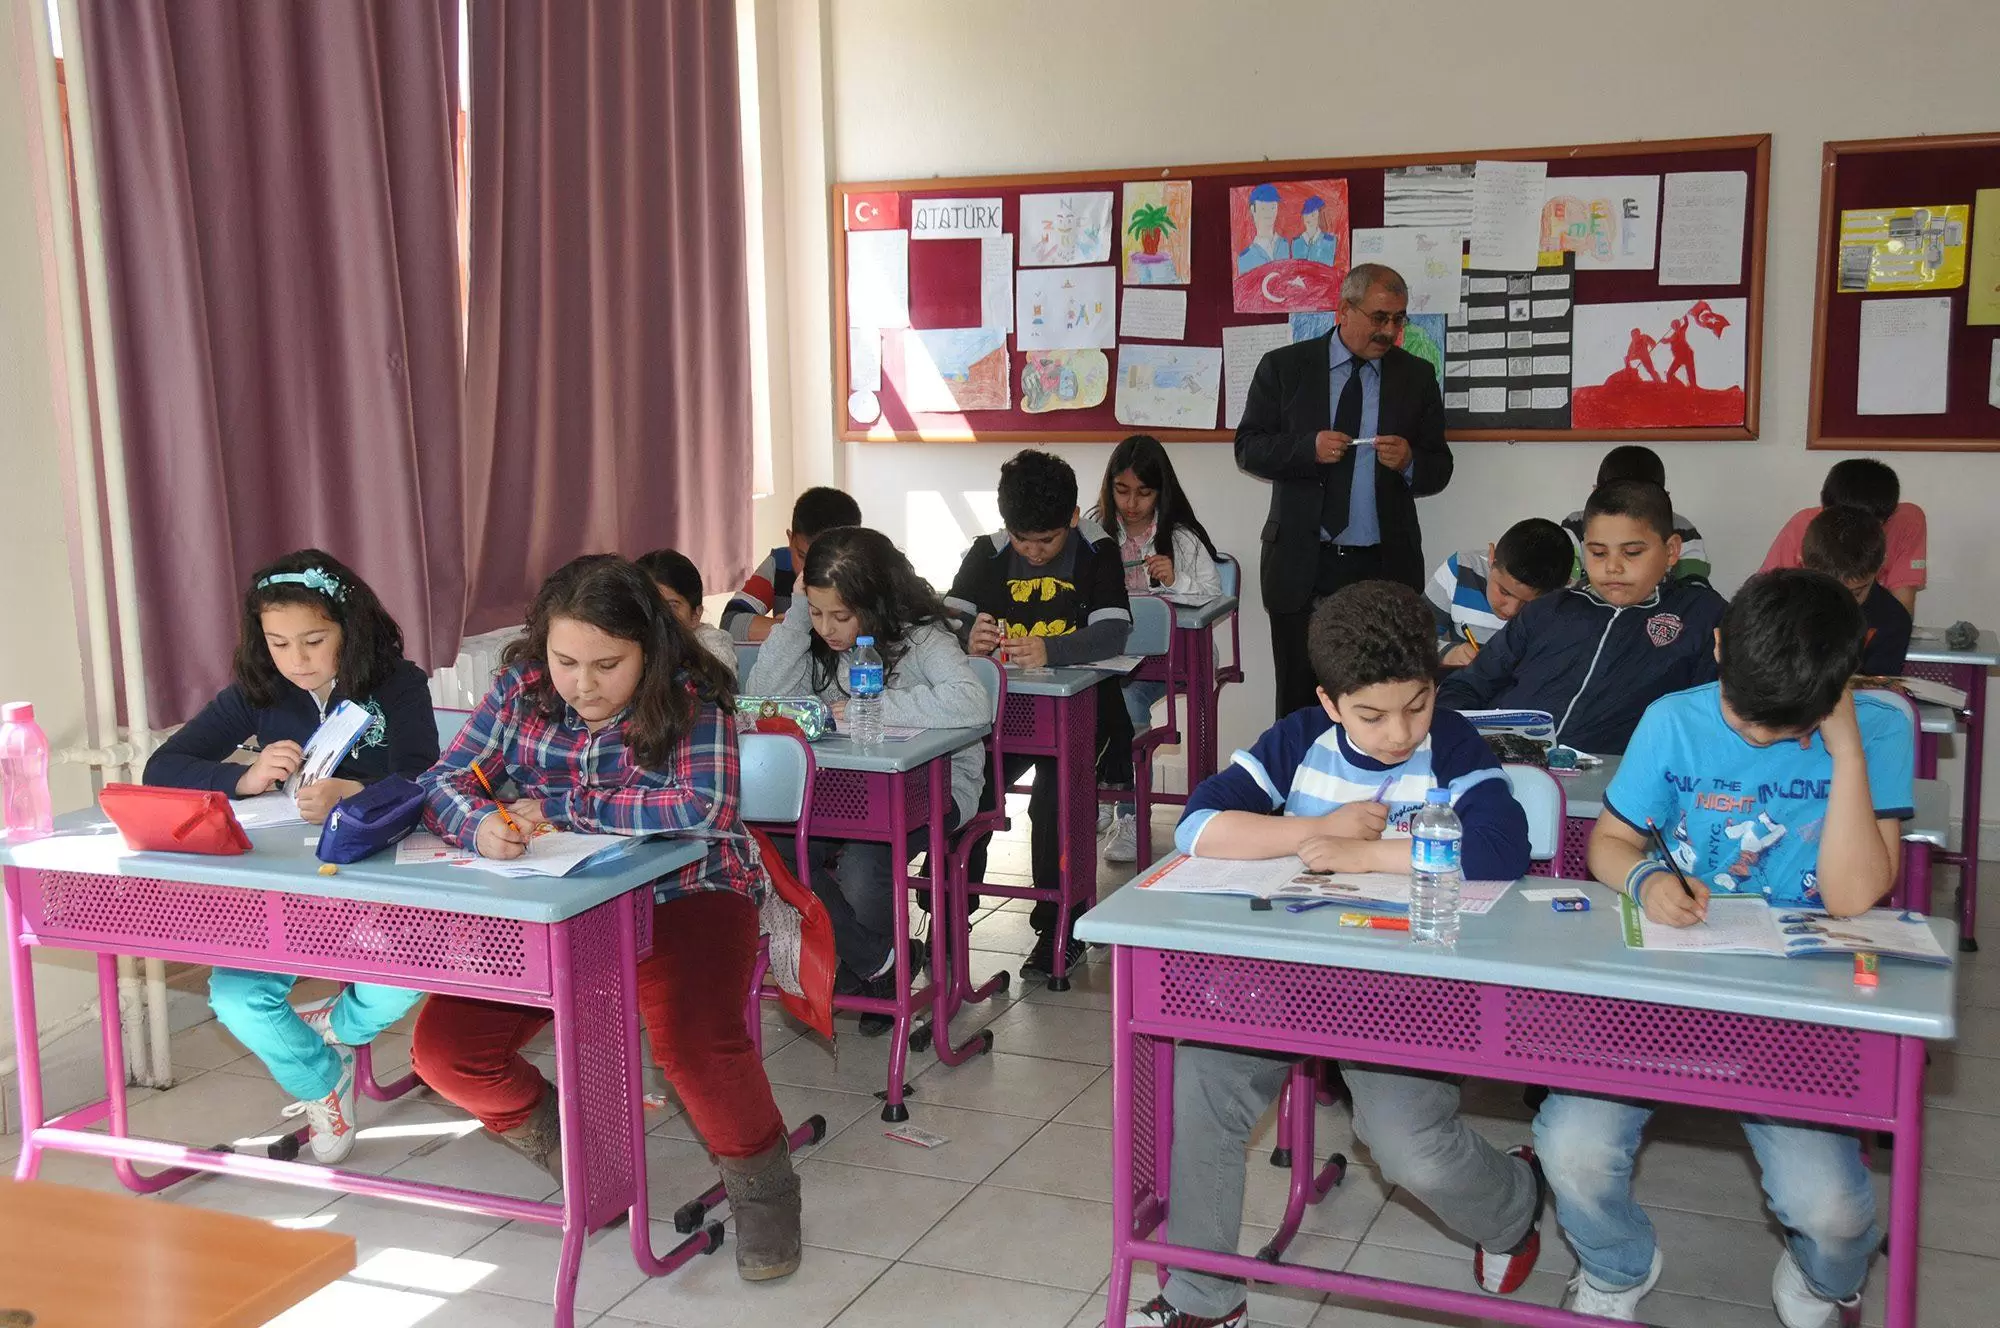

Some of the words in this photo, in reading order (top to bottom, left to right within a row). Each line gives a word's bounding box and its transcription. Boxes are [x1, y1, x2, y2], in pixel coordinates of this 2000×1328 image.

[914, 204, 1000, 231] ATATÜRK
[1712, 778, 1742, 792] THE
[1695, 792, 1757, 814] NIGHT
